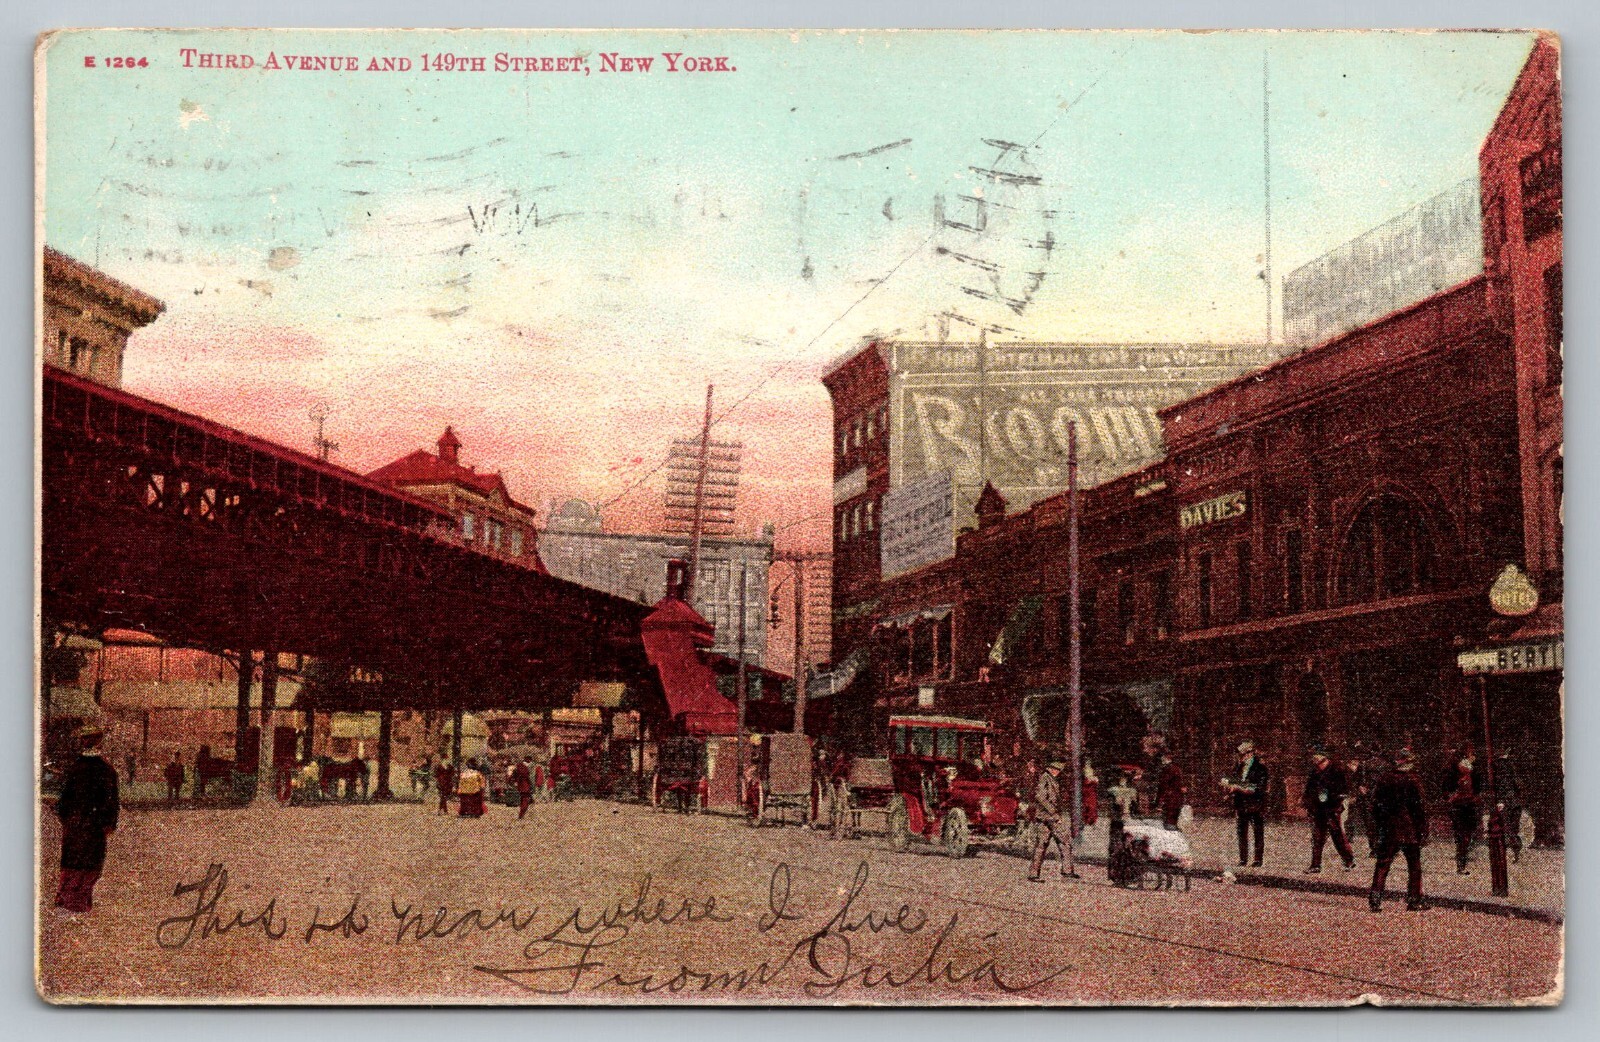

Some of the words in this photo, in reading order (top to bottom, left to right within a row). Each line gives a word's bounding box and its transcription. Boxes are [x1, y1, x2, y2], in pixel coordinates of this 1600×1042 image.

[1180, 493, 1247, 528] DAVIES
[157, 863, 287, 948] This
[304, 878, 367, 944] is
[391, 898, 534, 943] near
[544, 873, 734, 942] where
[757, 861, 804, 934] I
[820, 860, 927, 935] live
[473, 923, 800, 995] From
